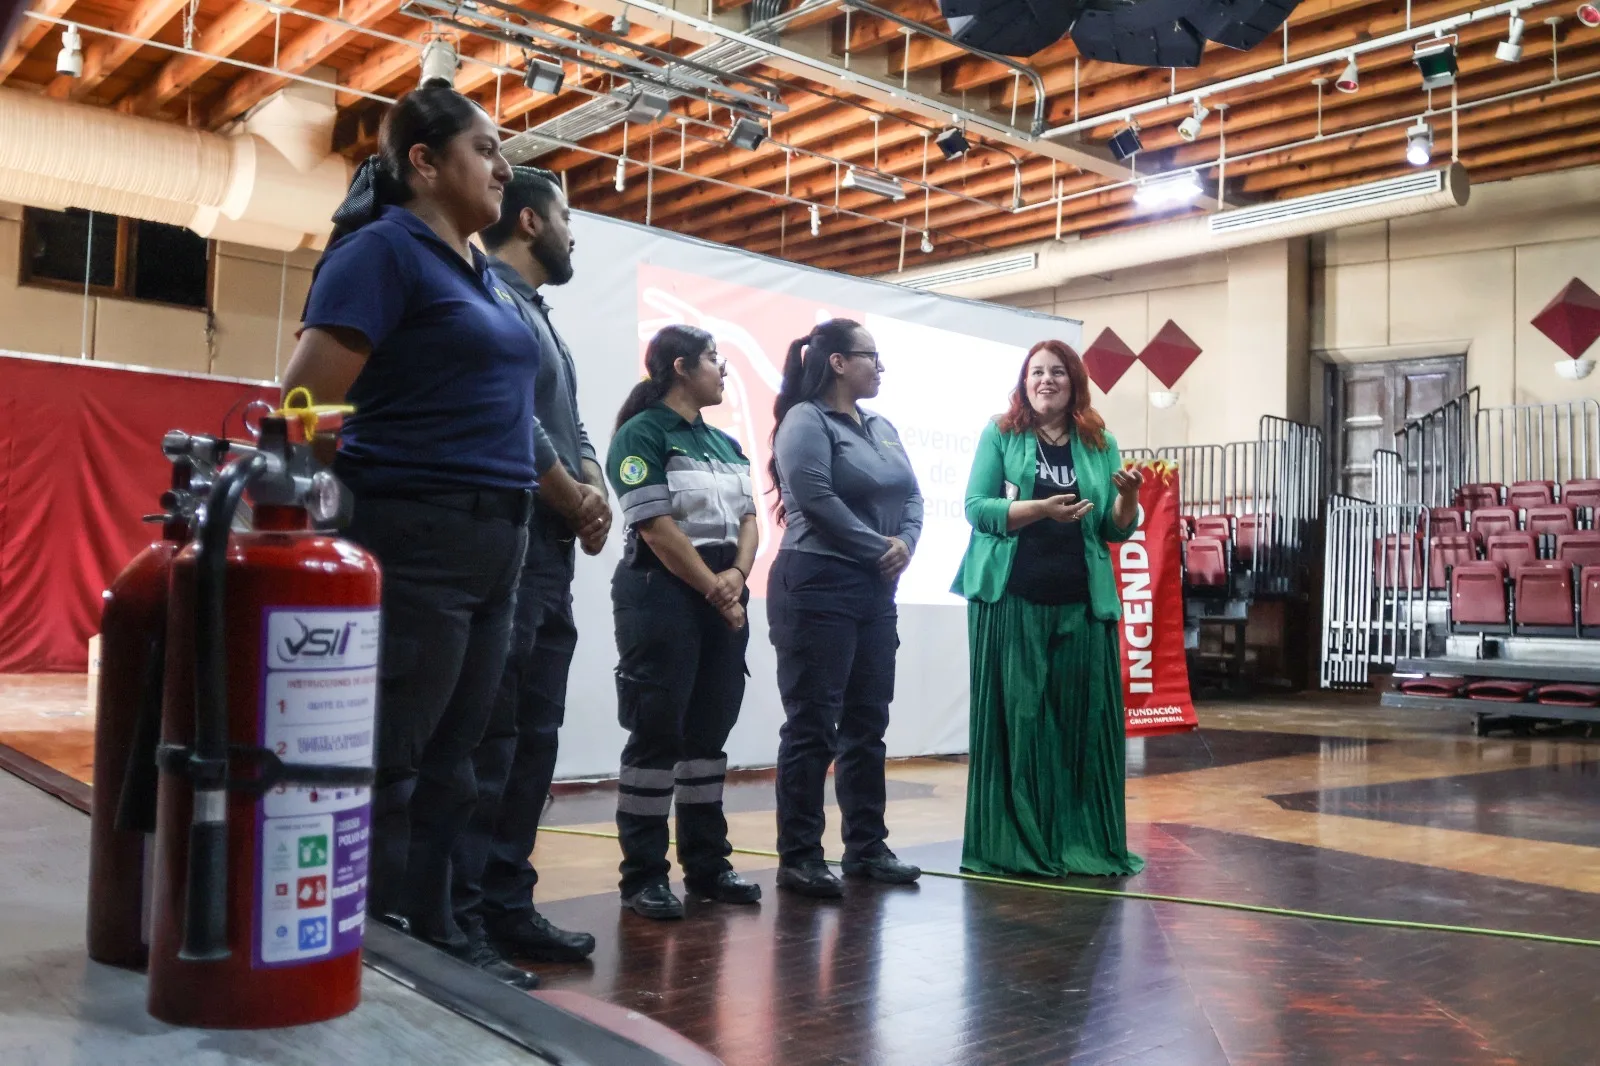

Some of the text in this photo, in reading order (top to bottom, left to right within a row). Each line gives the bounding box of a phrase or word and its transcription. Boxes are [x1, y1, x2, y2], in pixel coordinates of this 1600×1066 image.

[930, 459, 956, 485] de
[277, 700, 286, 714] 1
[1128, 705, 1182, 717] FUNDACIÓN
[1154, 716, 1184, 724] IMPERIAL
[276, 741, 287, 756] 2
